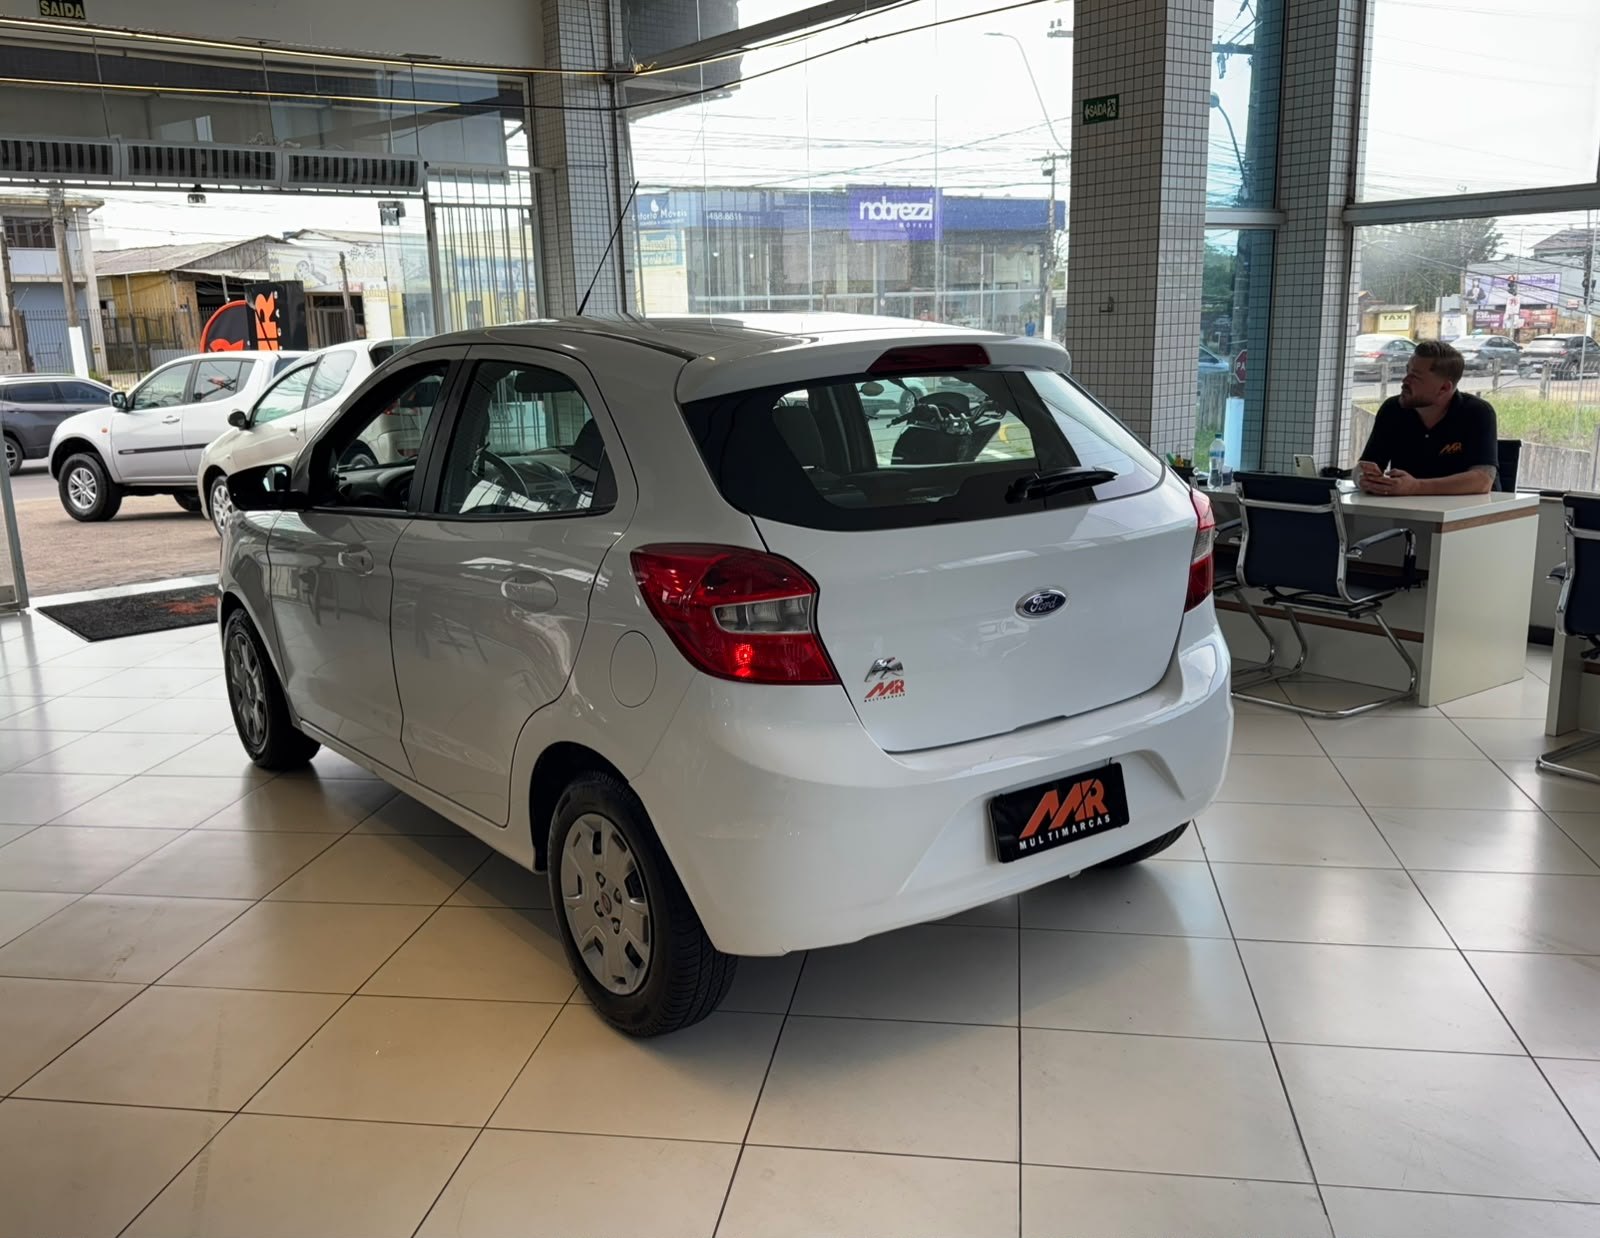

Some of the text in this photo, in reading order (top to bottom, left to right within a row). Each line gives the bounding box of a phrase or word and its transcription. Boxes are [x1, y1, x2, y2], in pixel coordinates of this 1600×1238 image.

[859, 195, 934, 221] nobrezzi
[1236, 361, 1247, 371] PA
[1031, 594, 1059, 613] Ford
[1019, 814, 1111, 850] MULTIMARCAS
